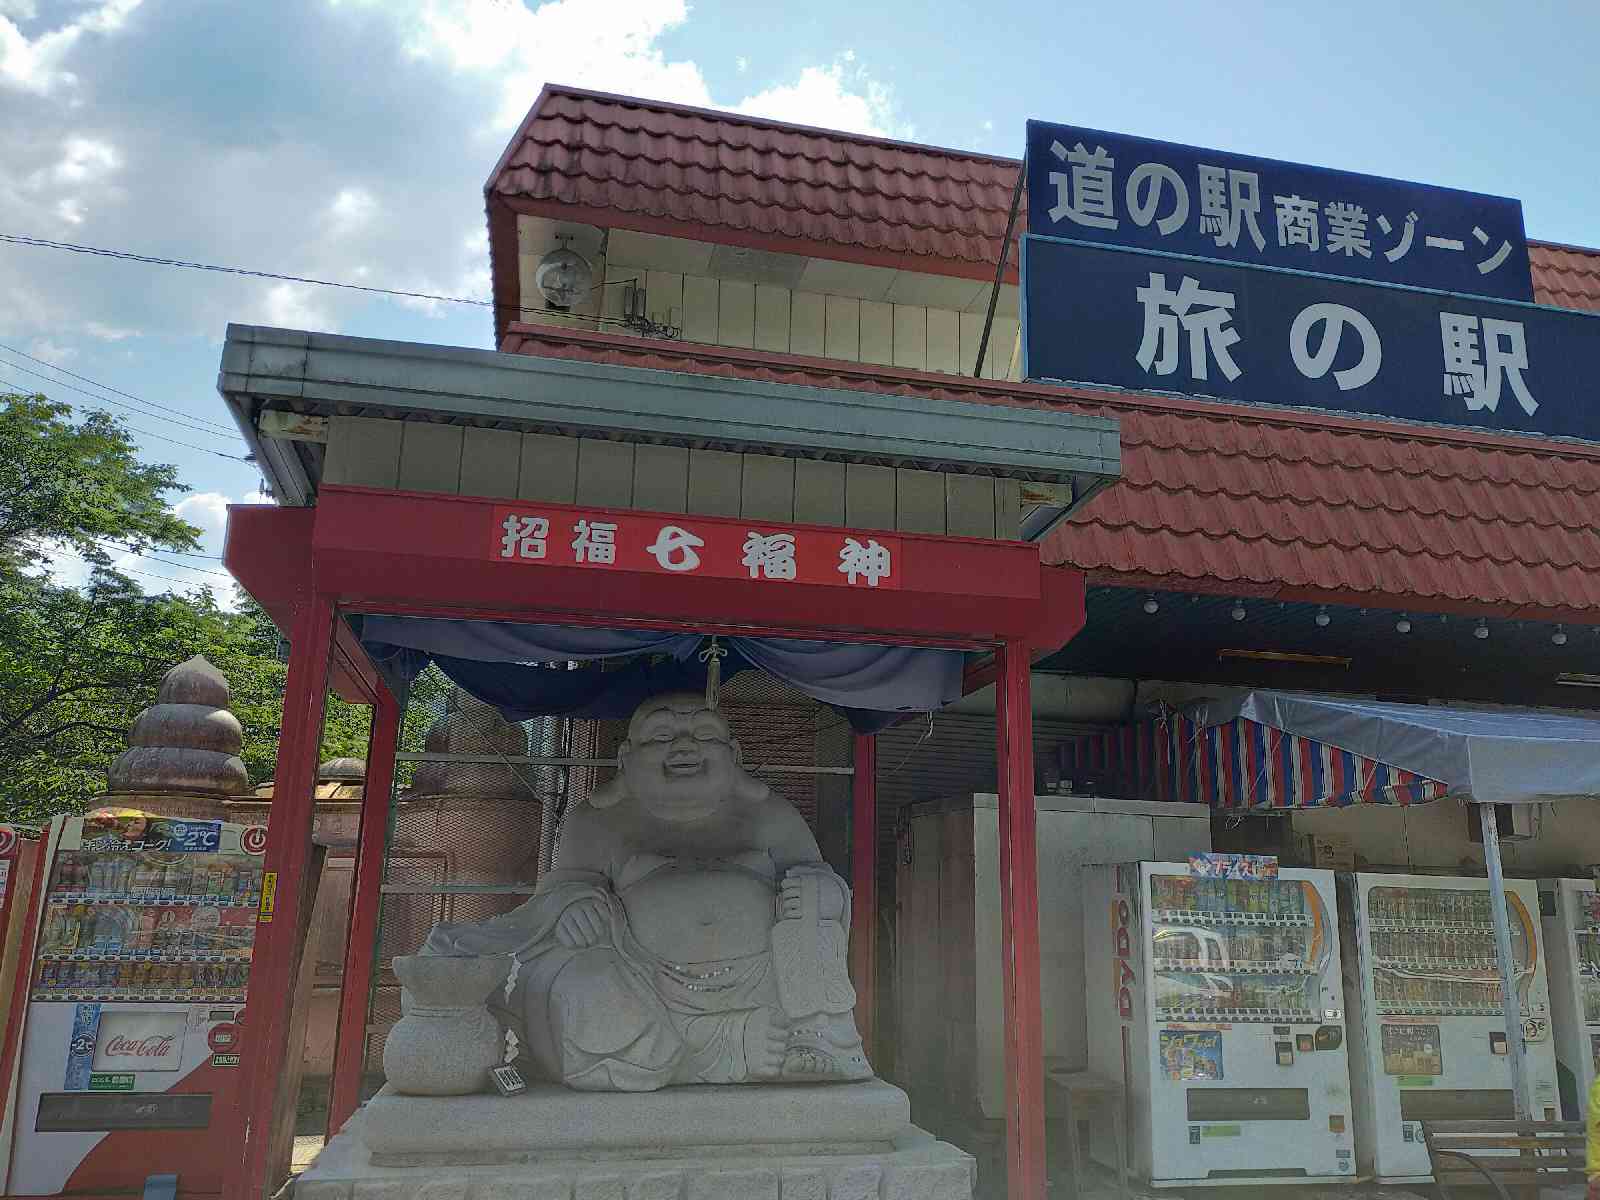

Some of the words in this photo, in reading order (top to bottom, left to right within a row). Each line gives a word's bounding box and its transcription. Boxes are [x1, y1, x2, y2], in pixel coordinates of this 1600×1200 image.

[1049, 140, 1512, 275] 道の駅商業ゾーン
[1135, 272, 1539, 417] 旅の駅
[1118, 900, 1136, 1017] DyDo
